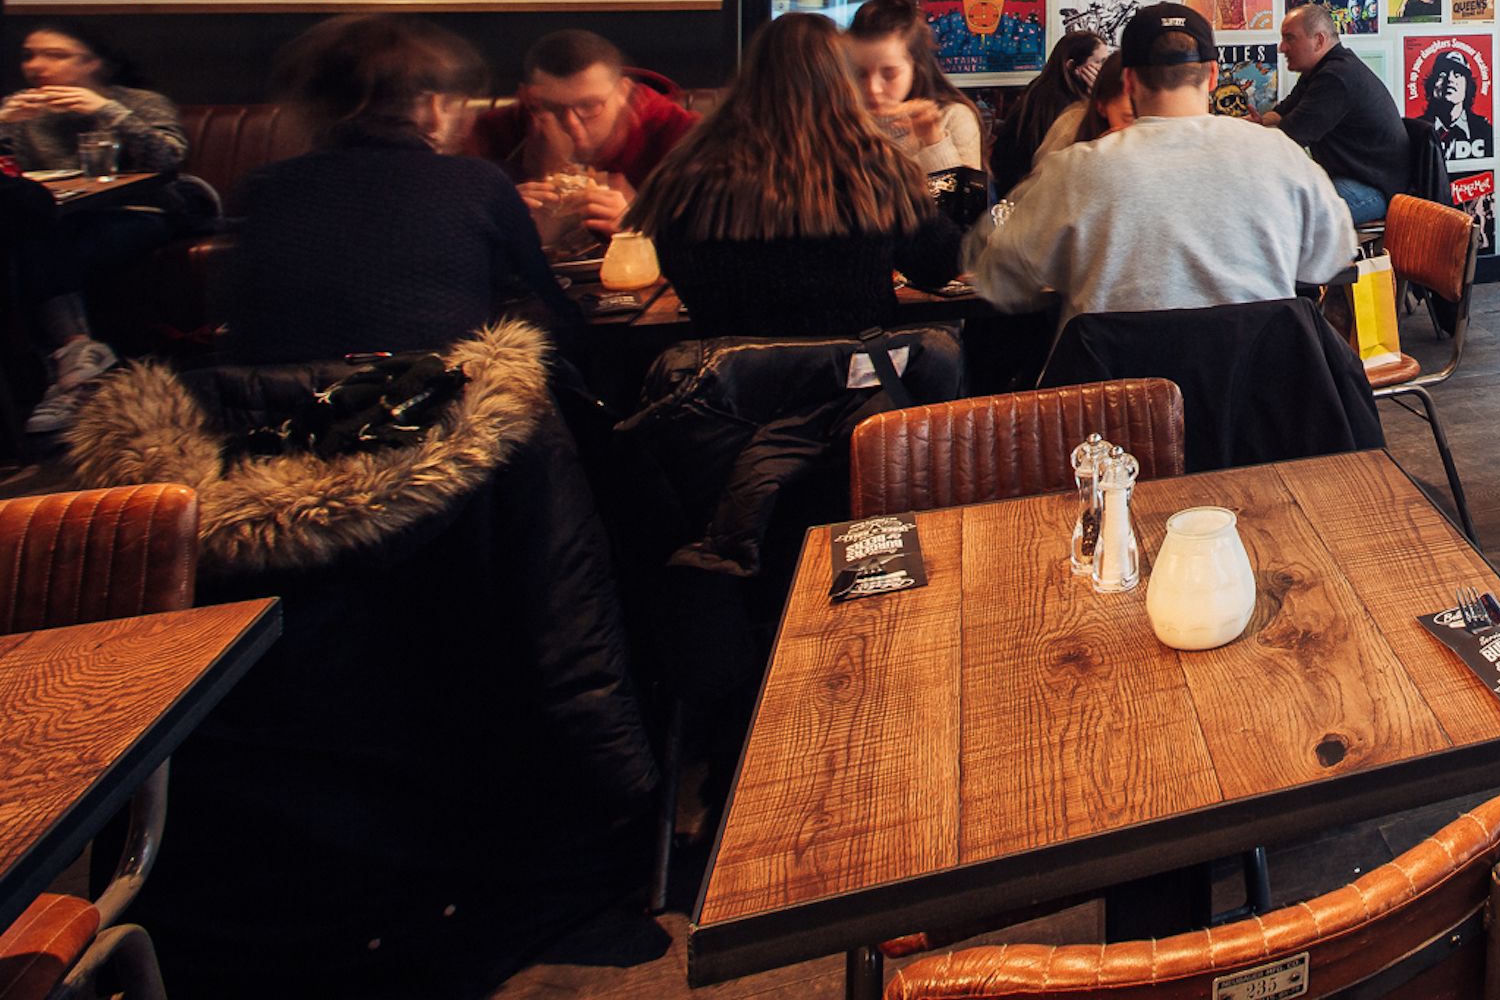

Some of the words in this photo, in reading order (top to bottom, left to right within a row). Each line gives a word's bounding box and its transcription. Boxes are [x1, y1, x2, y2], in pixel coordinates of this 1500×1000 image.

[1453, 0, 1488, 13] QUEENS
[1217, 46, 1266, 64] XIES
[1246, 977, 1278, 999] 235
